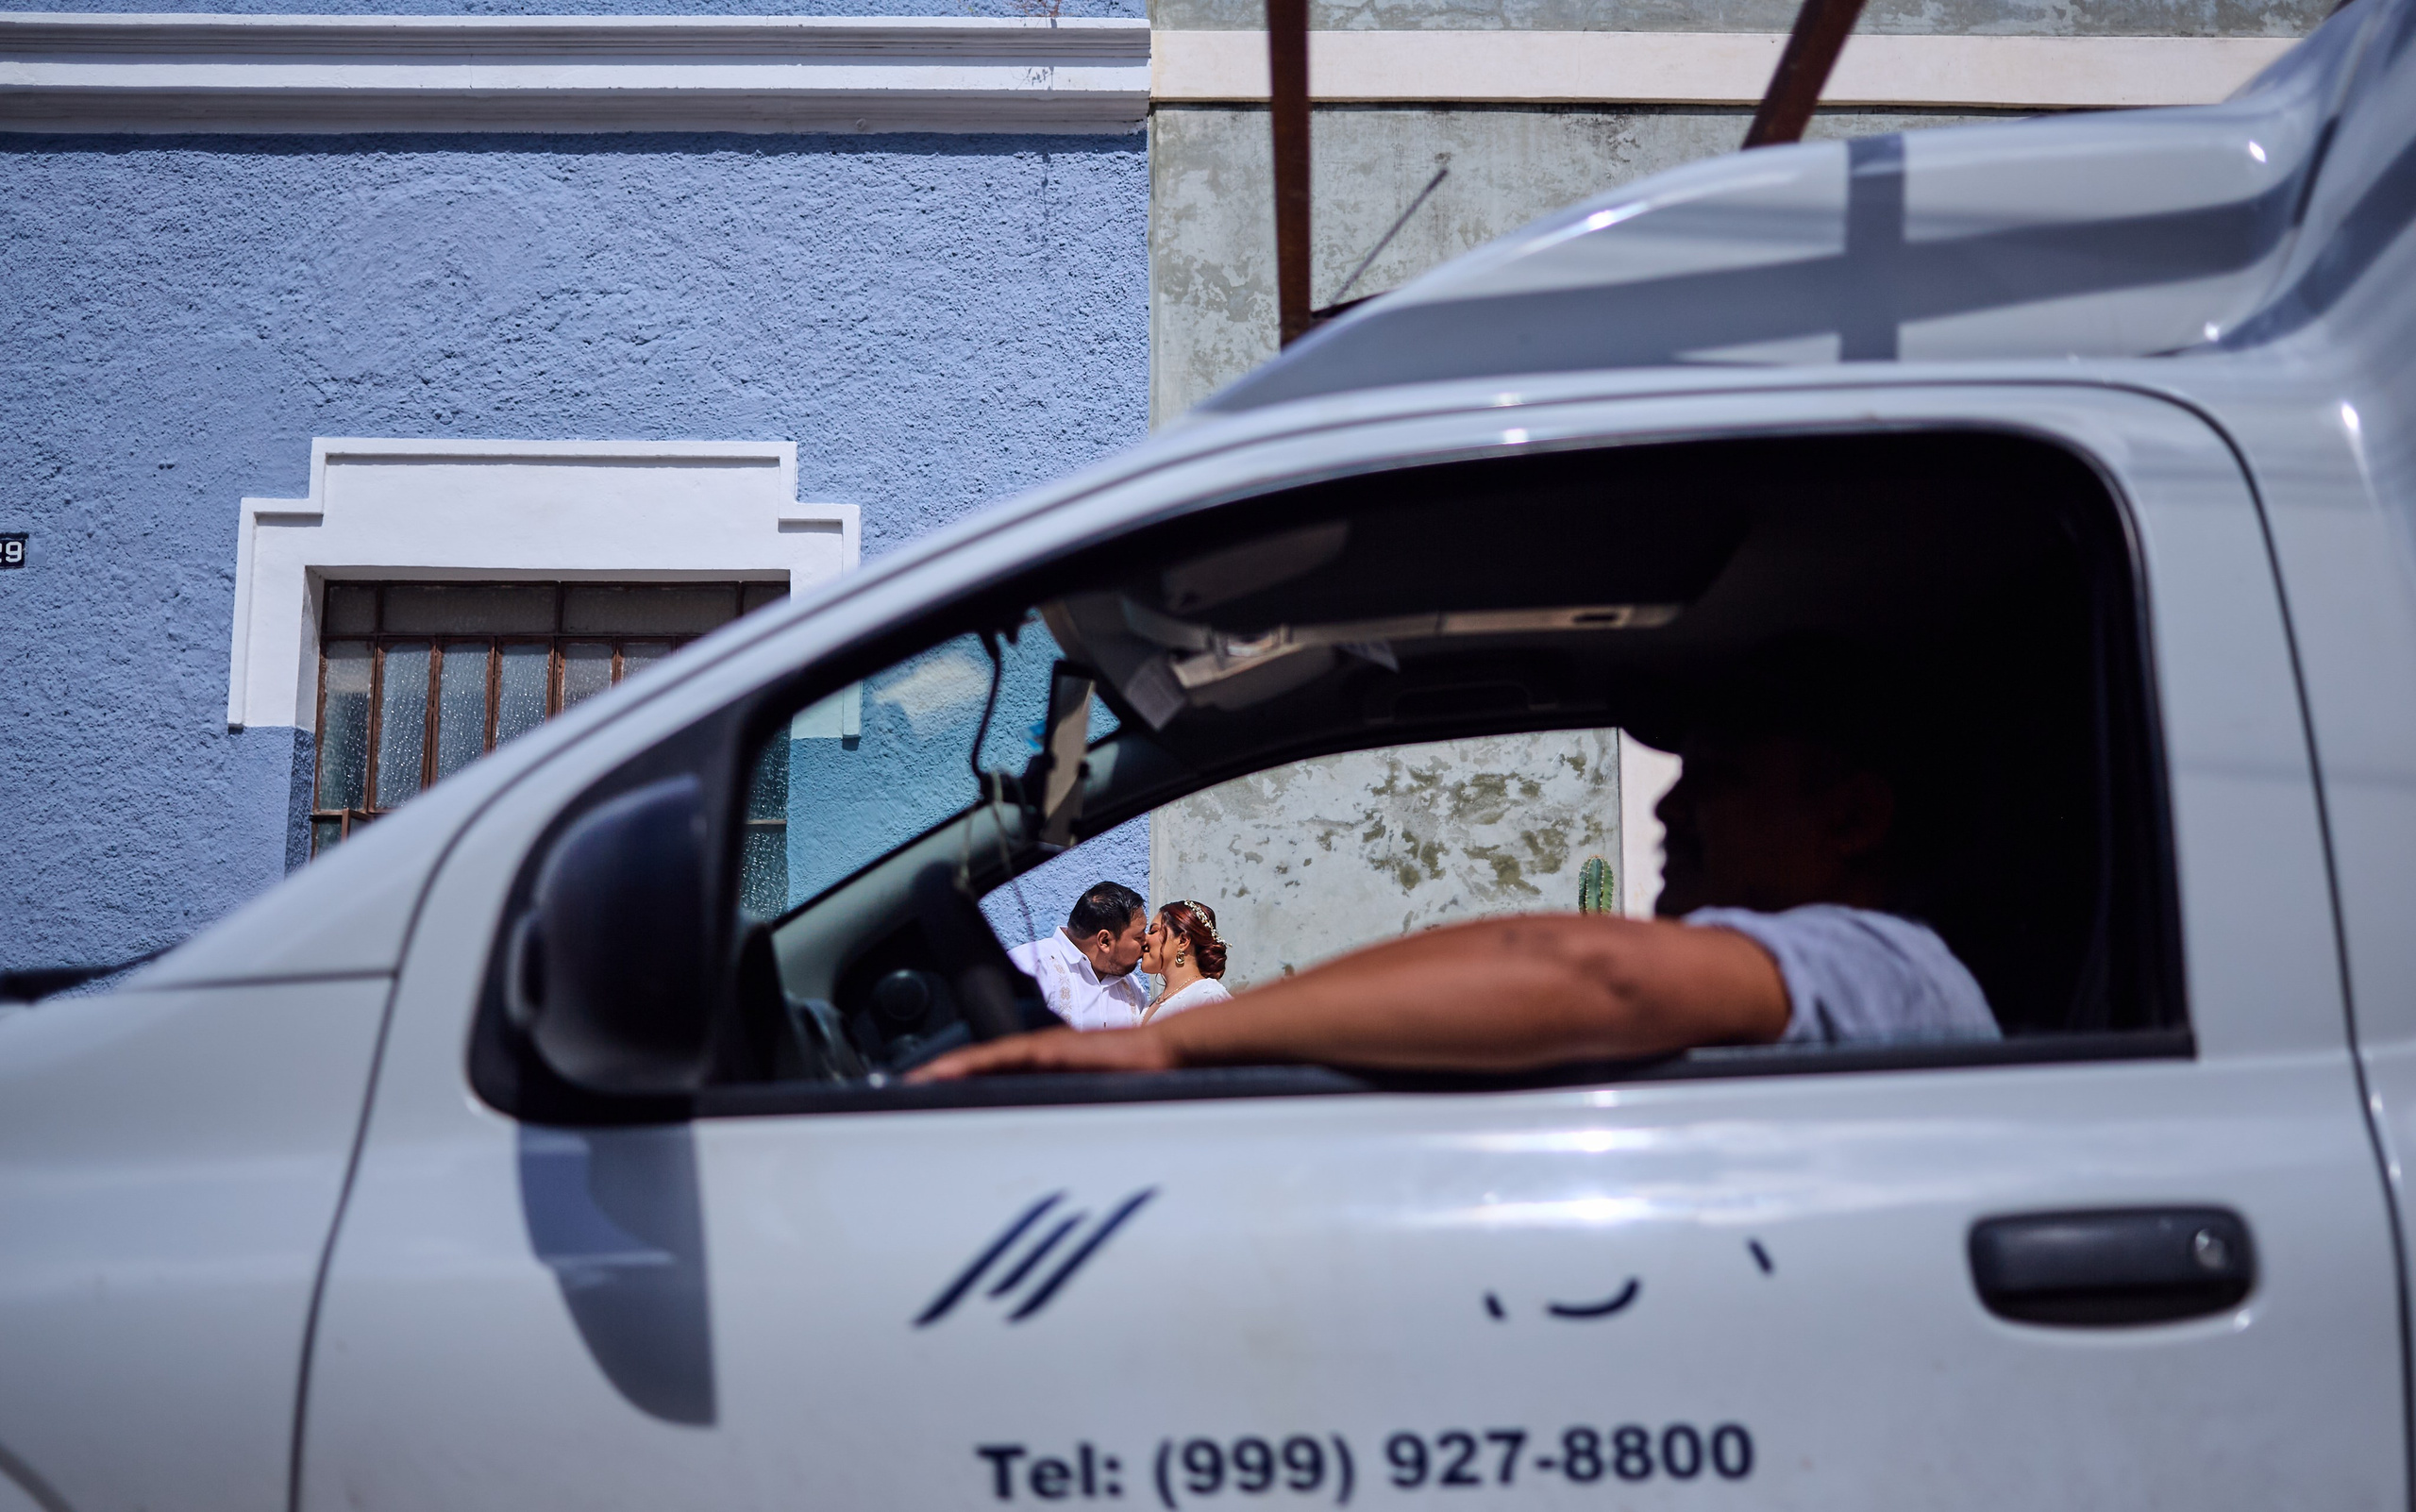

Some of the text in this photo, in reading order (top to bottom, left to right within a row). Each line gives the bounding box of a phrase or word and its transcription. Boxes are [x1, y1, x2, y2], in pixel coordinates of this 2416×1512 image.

[0, 542, 23, 563] 9
[973, 1422, 1757, 1512] Tel: (999) 927-8800
